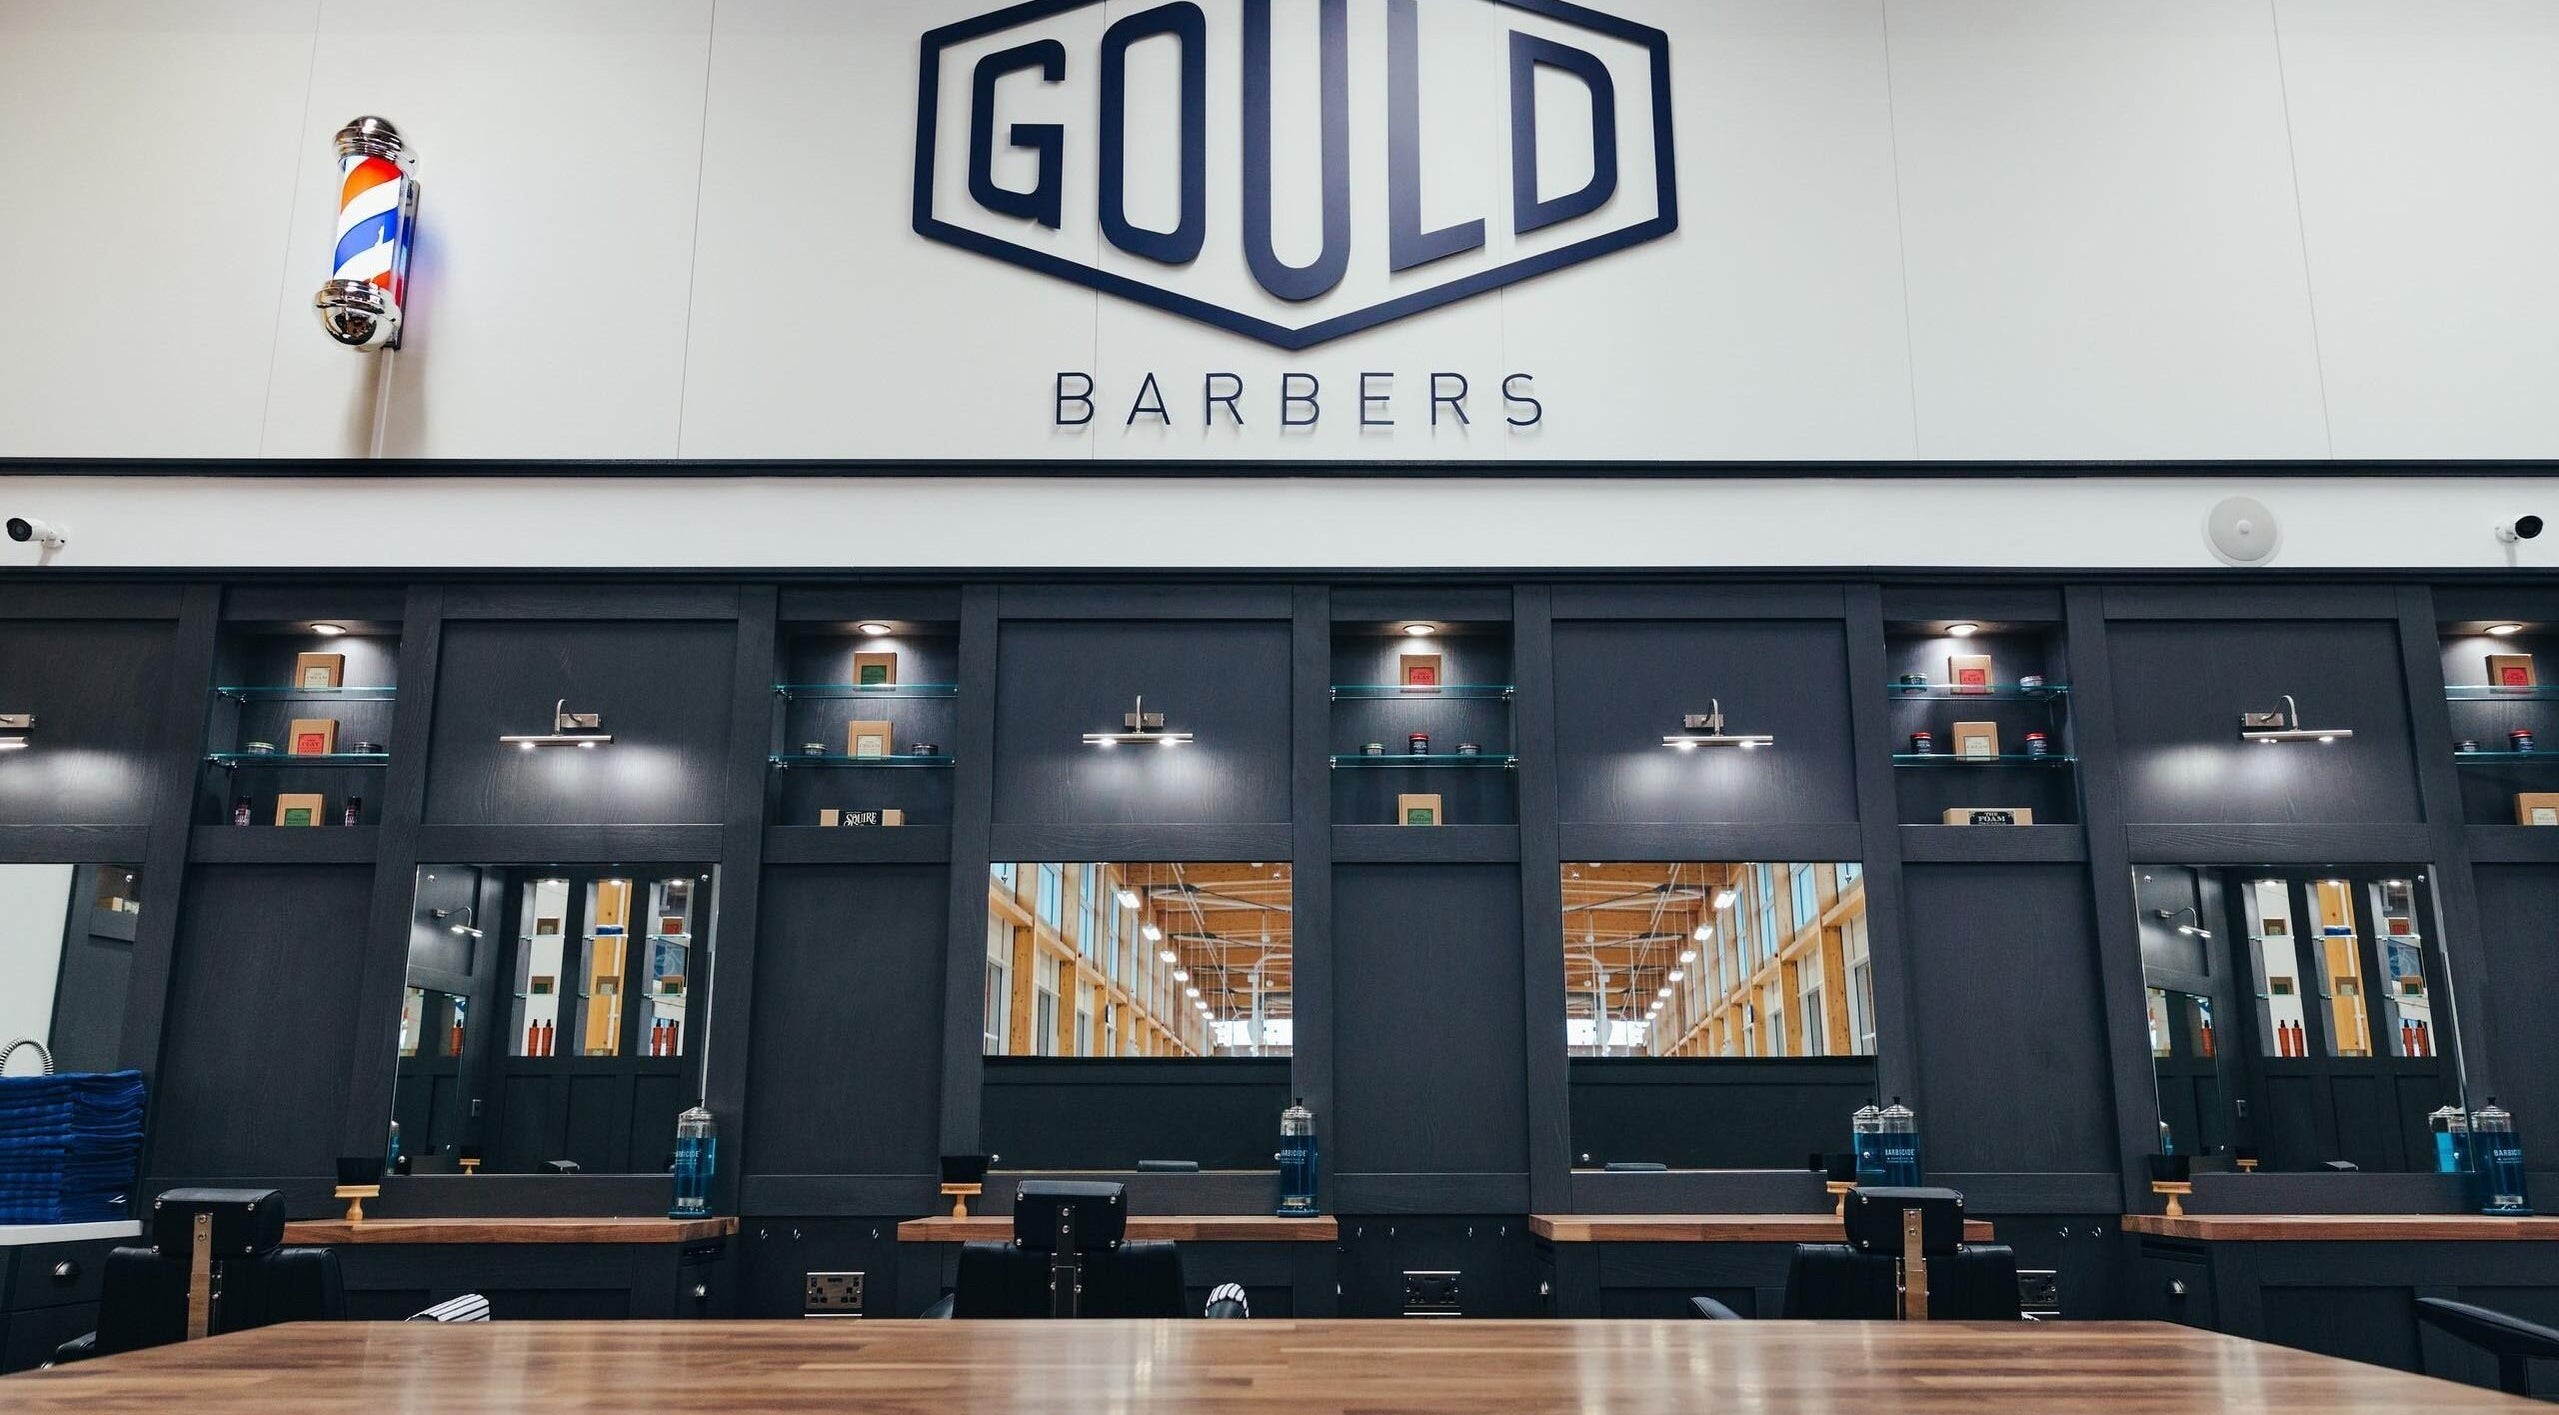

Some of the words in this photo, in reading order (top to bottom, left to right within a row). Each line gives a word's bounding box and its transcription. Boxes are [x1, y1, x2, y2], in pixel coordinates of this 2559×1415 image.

[967, 0, 1617, 301] GOULD
[1055, 371, 1543, 426] BARBERS
[843, 811, 877, 826] SQUIRE
